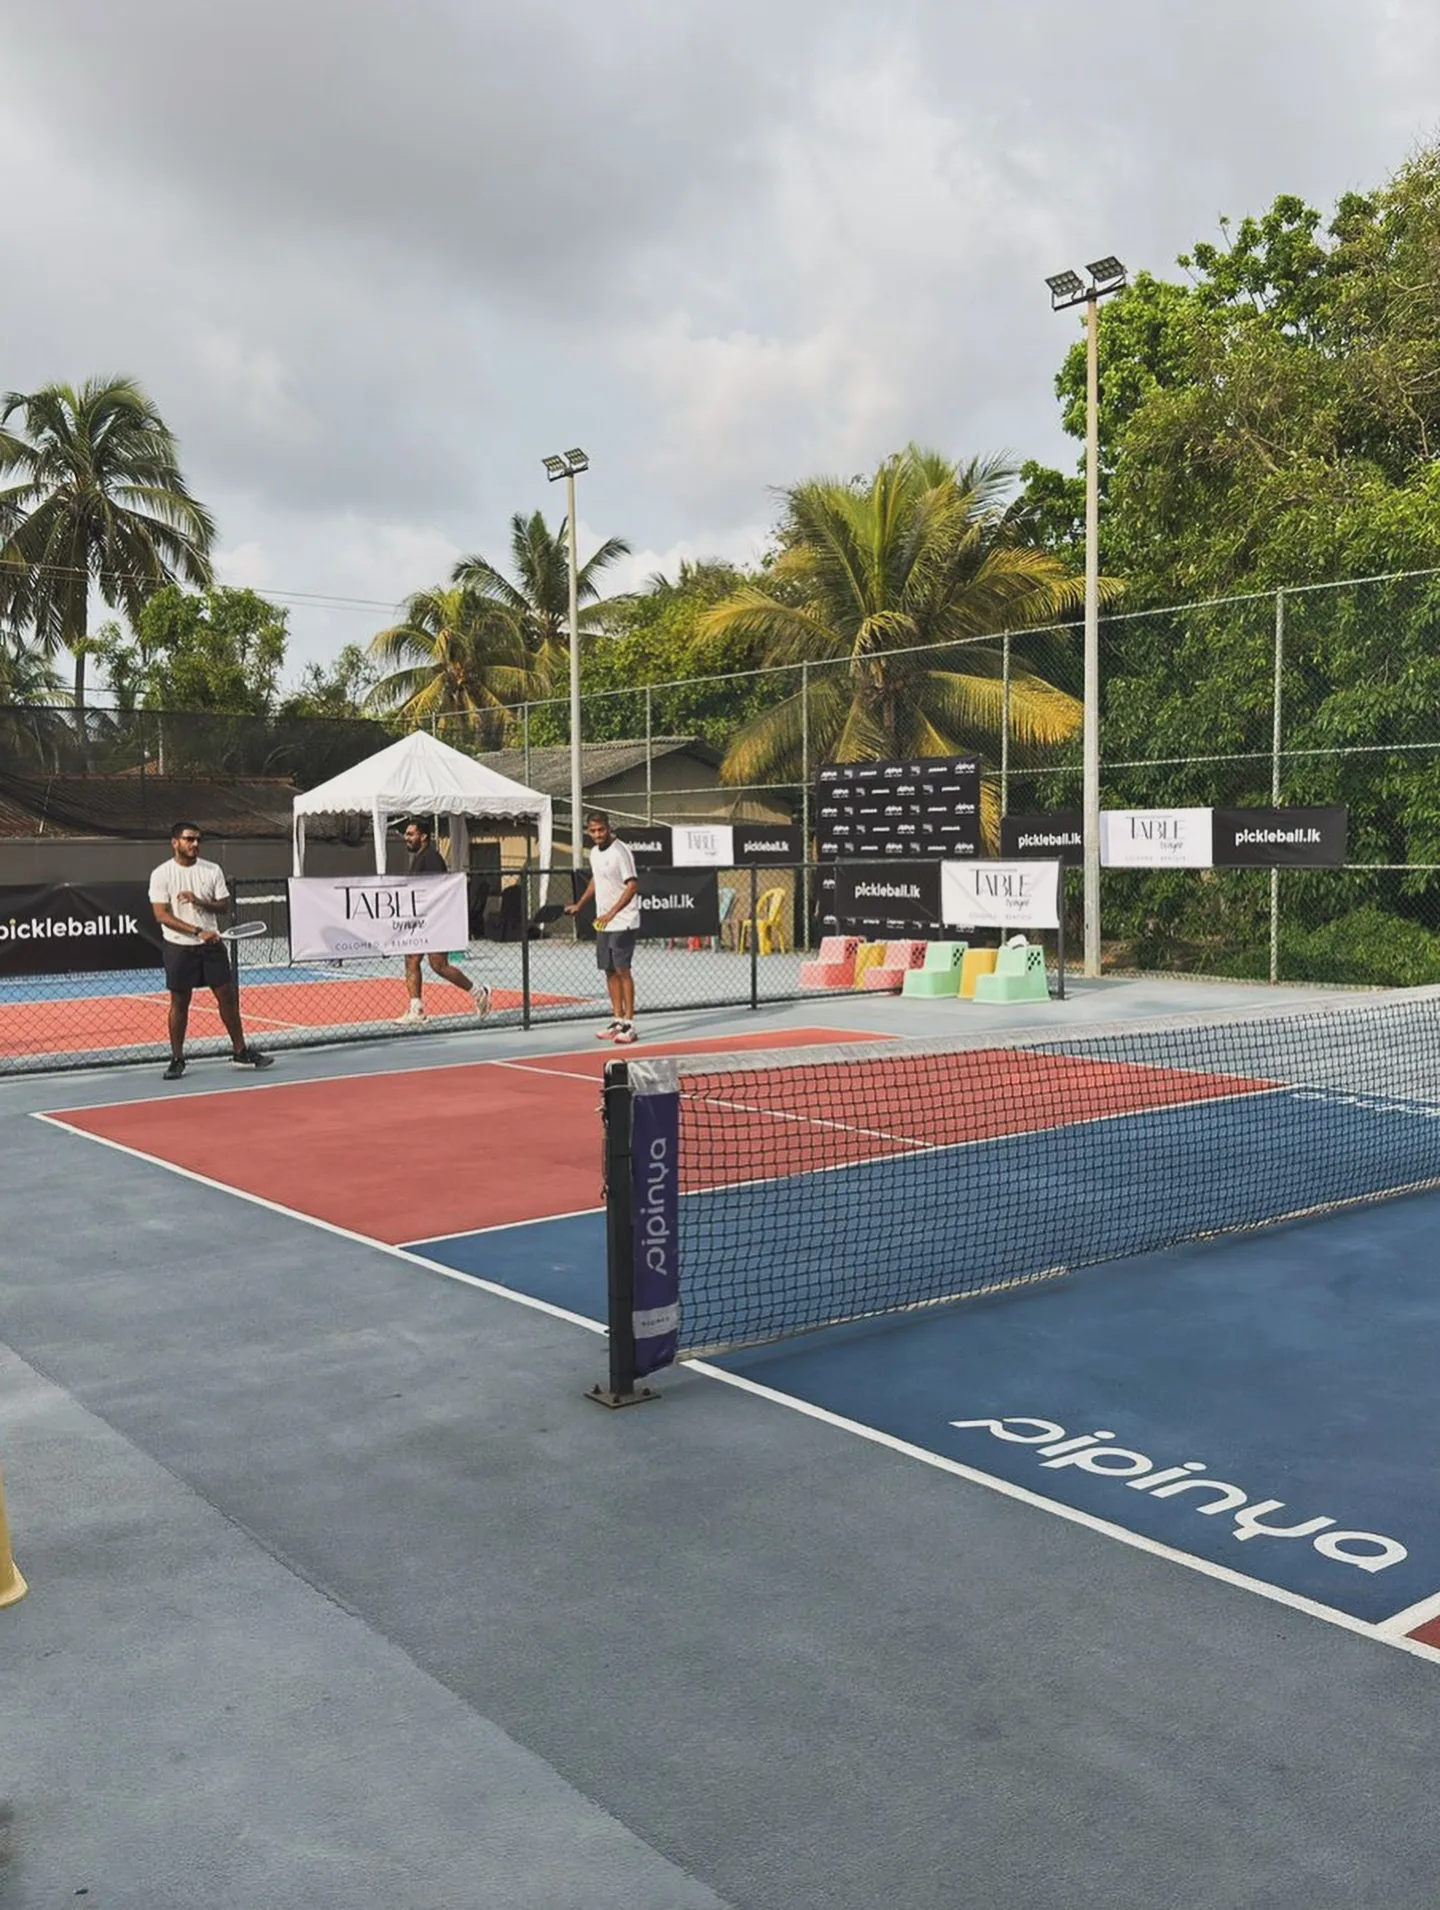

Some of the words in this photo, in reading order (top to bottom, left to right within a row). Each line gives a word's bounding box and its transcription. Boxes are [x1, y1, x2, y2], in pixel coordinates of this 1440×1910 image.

[1018, 832, 1081, 849] pickleball.lk
[1235, 828, 1321, 846] pickleball.lk
[855, 881, 921, 898] pickleball.lk
[969, 868, 1032, 897] TABLE
[334, 884, 428, 920] TABLE
